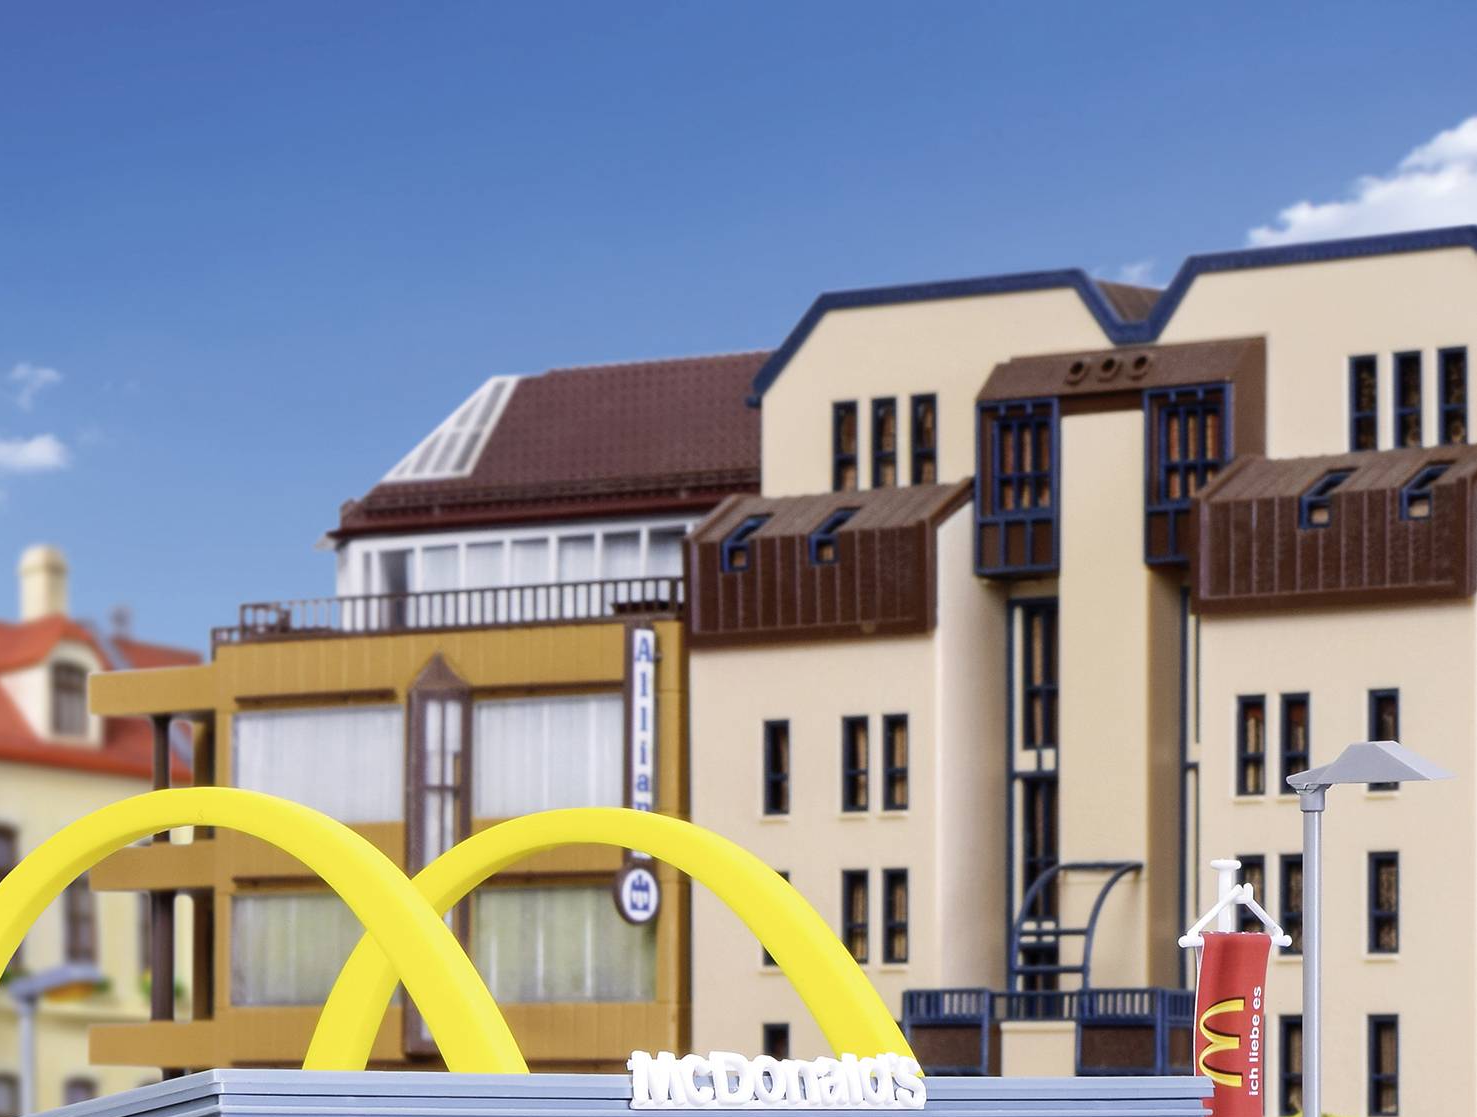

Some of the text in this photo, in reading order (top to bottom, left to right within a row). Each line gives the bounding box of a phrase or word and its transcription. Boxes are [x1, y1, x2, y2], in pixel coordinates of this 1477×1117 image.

[629, 1050, 927, 1108] McDonald's
[1248, 986, 1262, 1096] ich liebe es
